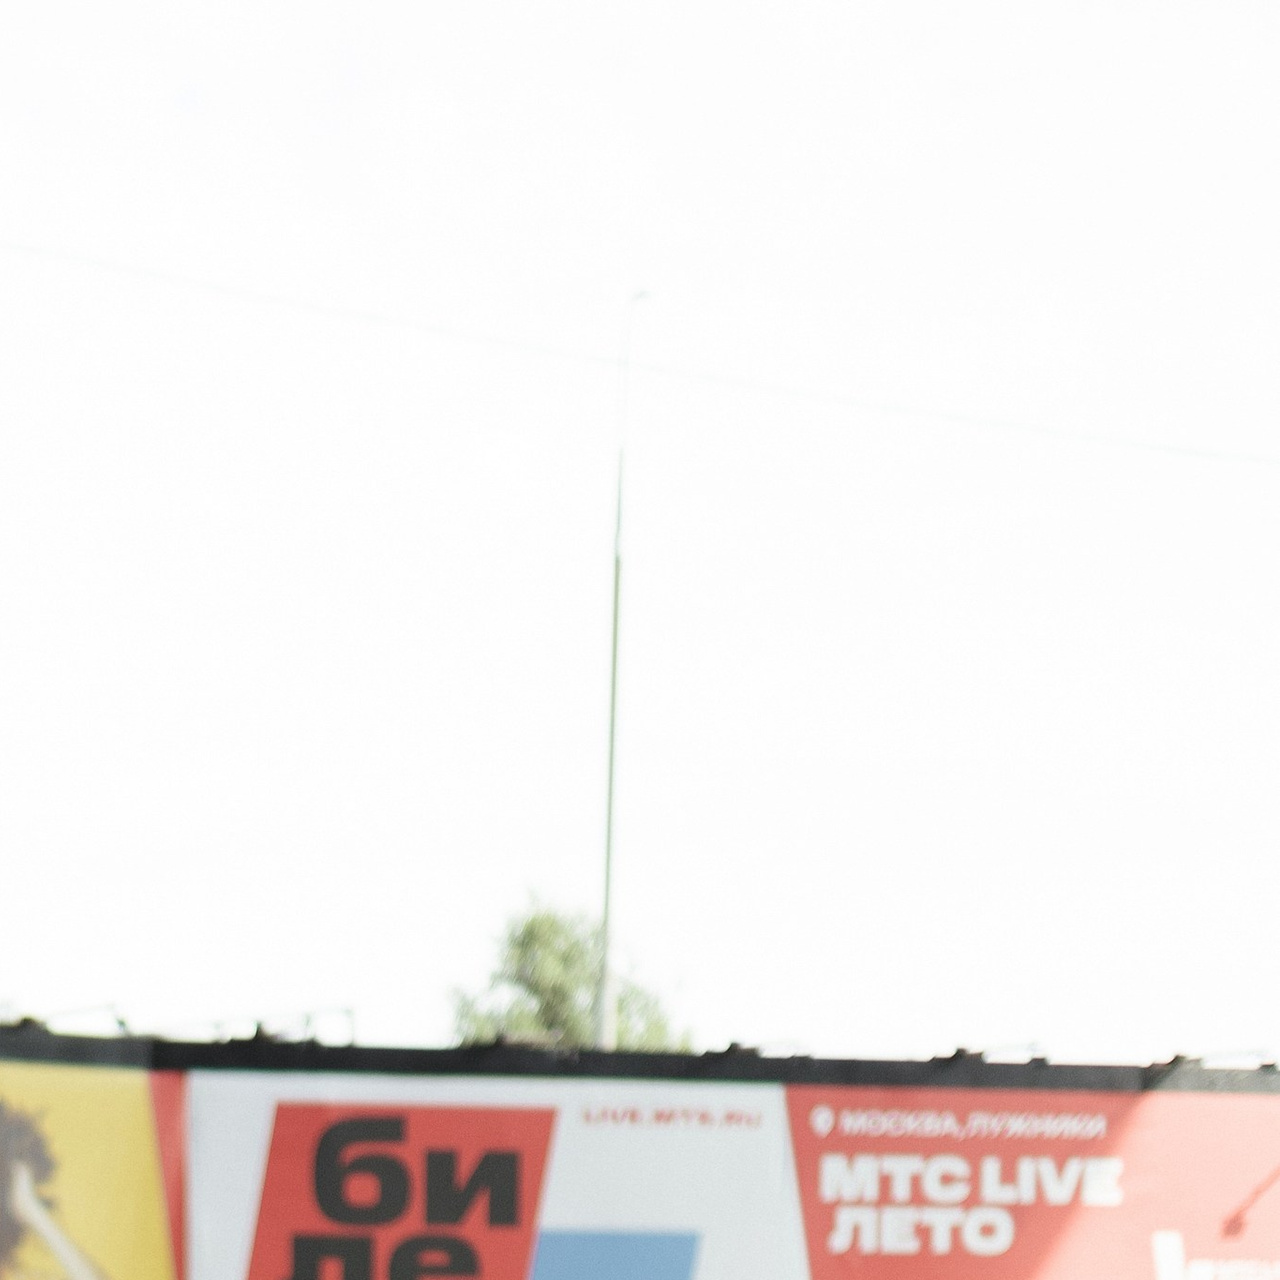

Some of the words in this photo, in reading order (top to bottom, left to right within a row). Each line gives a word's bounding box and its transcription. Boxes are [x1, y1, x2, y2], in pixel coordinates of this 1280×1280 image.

[313, 1116, 520, 1227] би
[821, 1154, 970, 1204] МТС
[980, 1155, 1123, 1206] LIVE
[828, 1205, 1014, 1256] ЛЕТО
